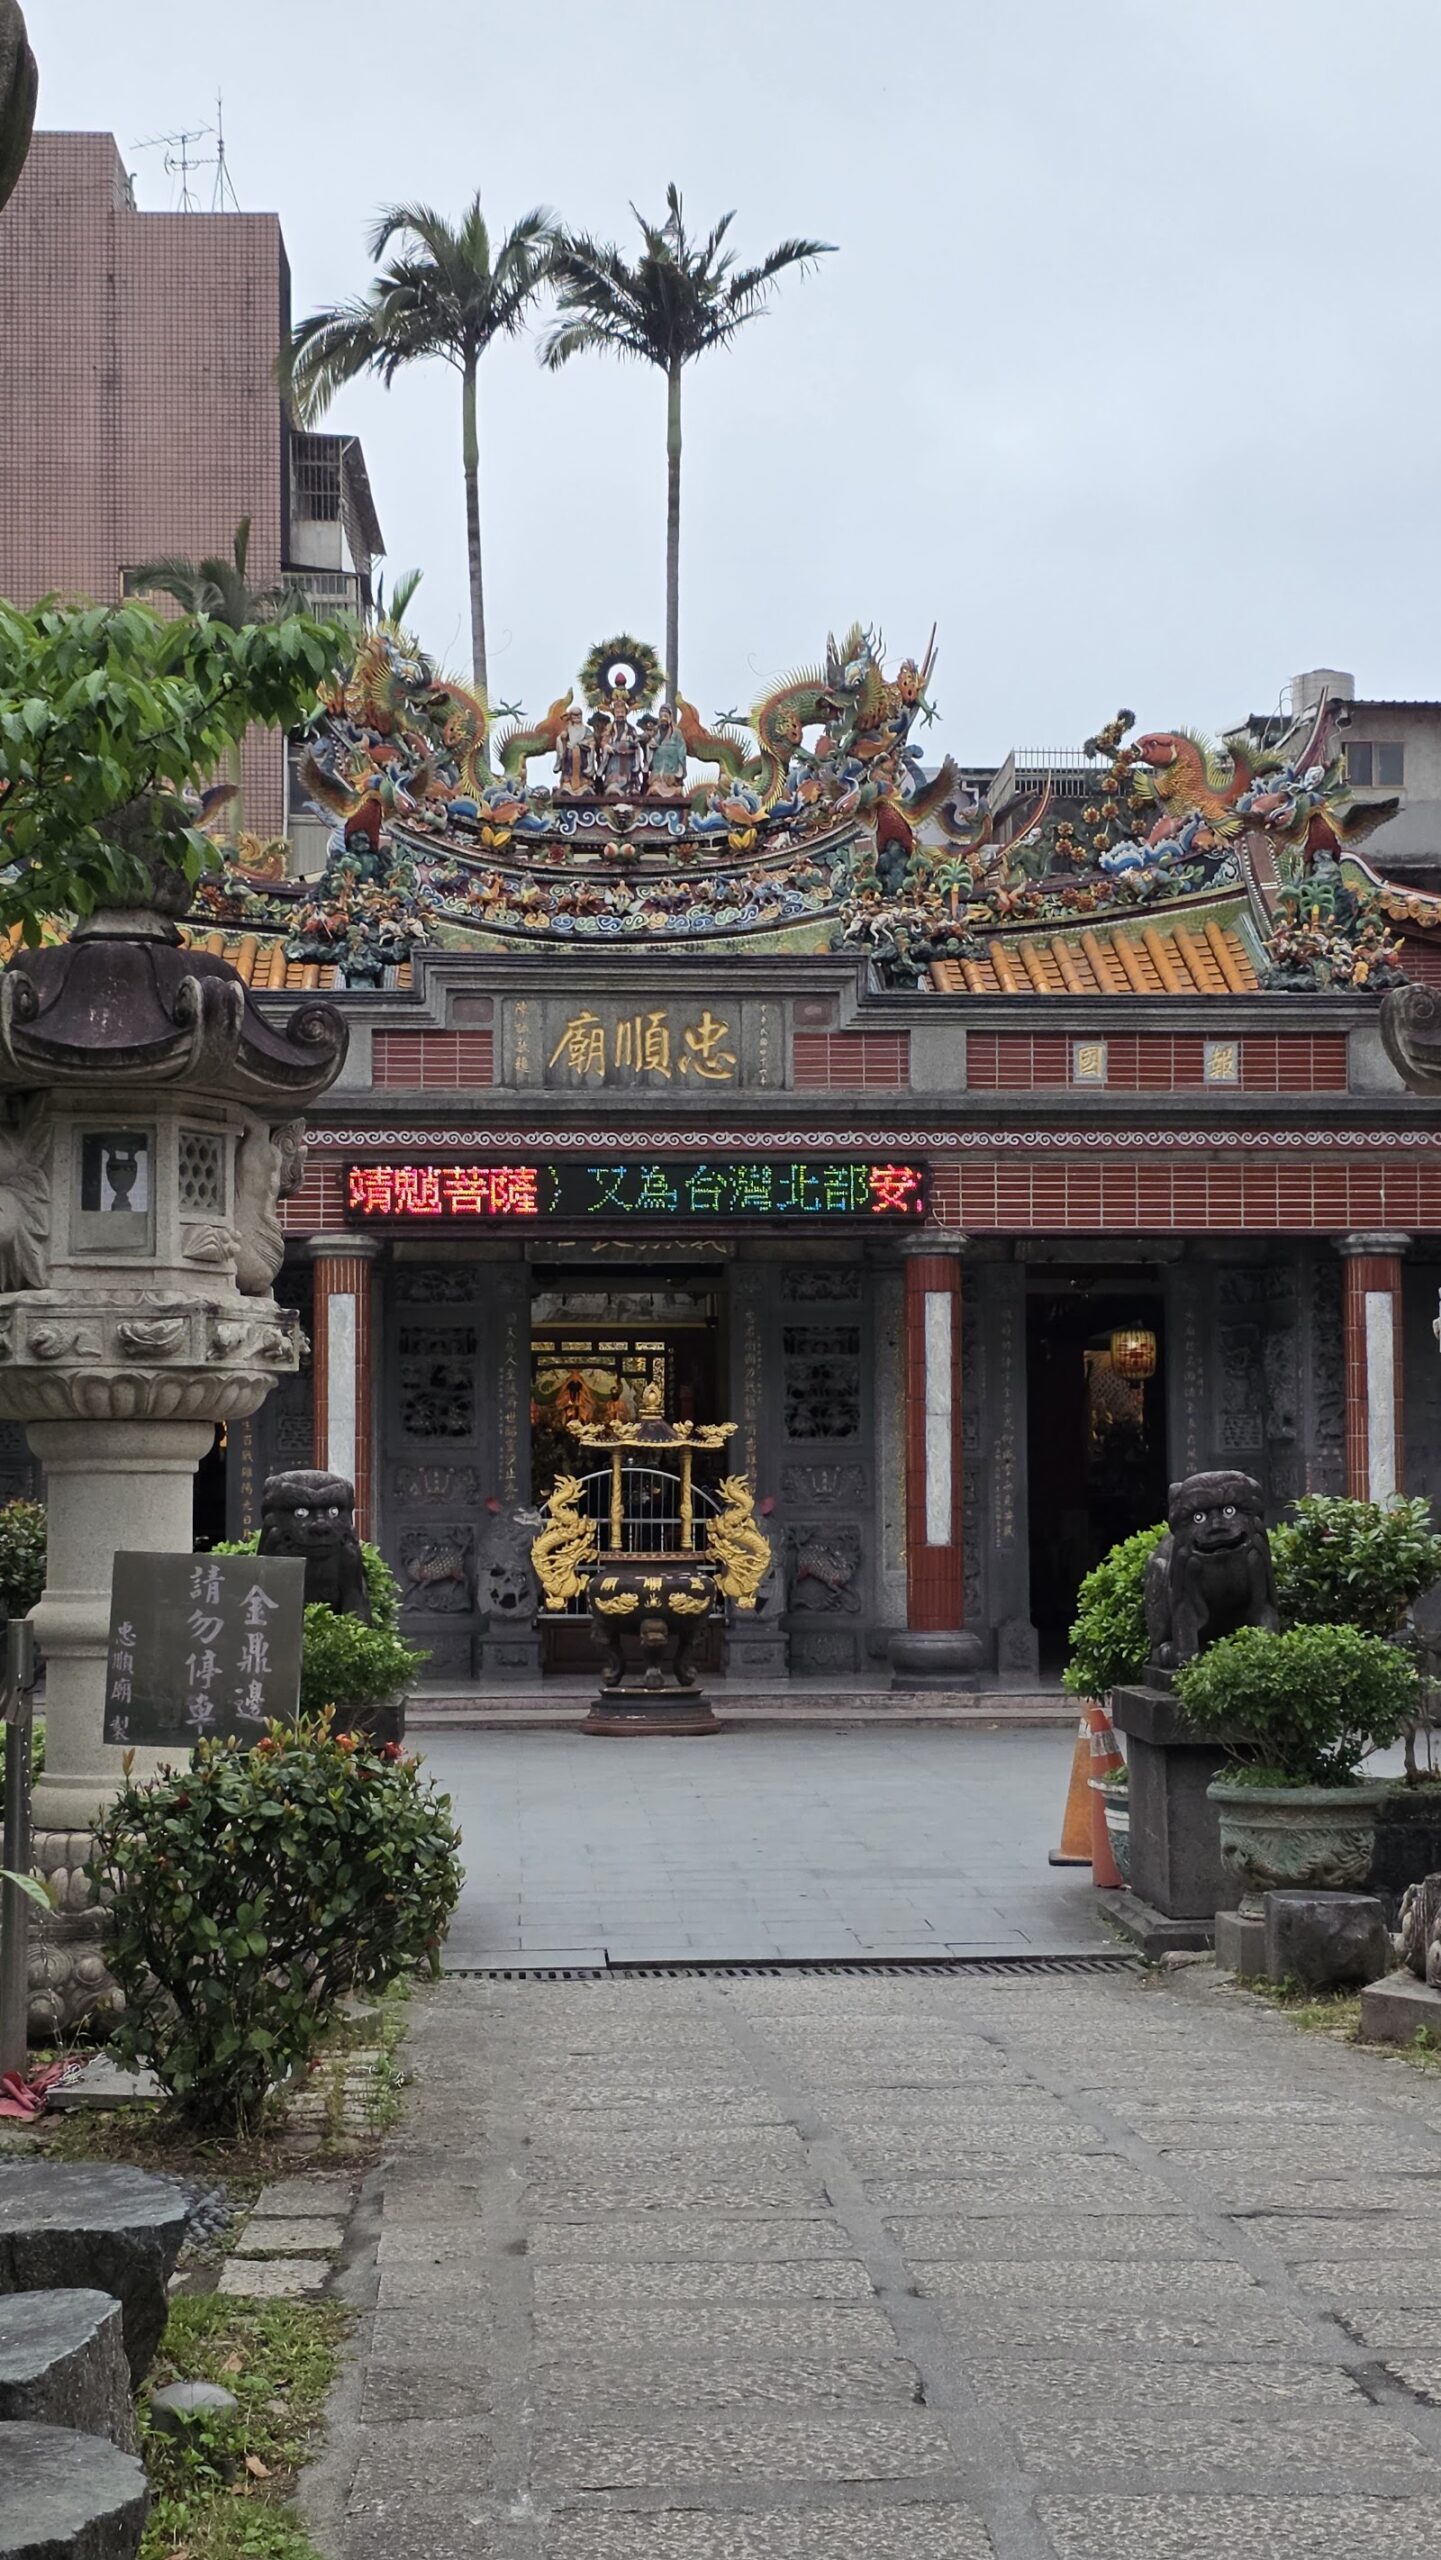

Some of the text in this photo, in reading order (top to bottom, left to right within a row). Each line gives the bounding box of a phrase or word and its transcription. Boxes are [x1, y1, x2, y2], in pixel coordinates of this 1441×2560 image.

[549, 1007, 736, 1080] 忠順廟
[109, 1620, 137, 1742] 忠順廟製
[184, 1564, 226, 1735] 請勿停車
[234, 1584, 279, 1723] 金鼎邊
